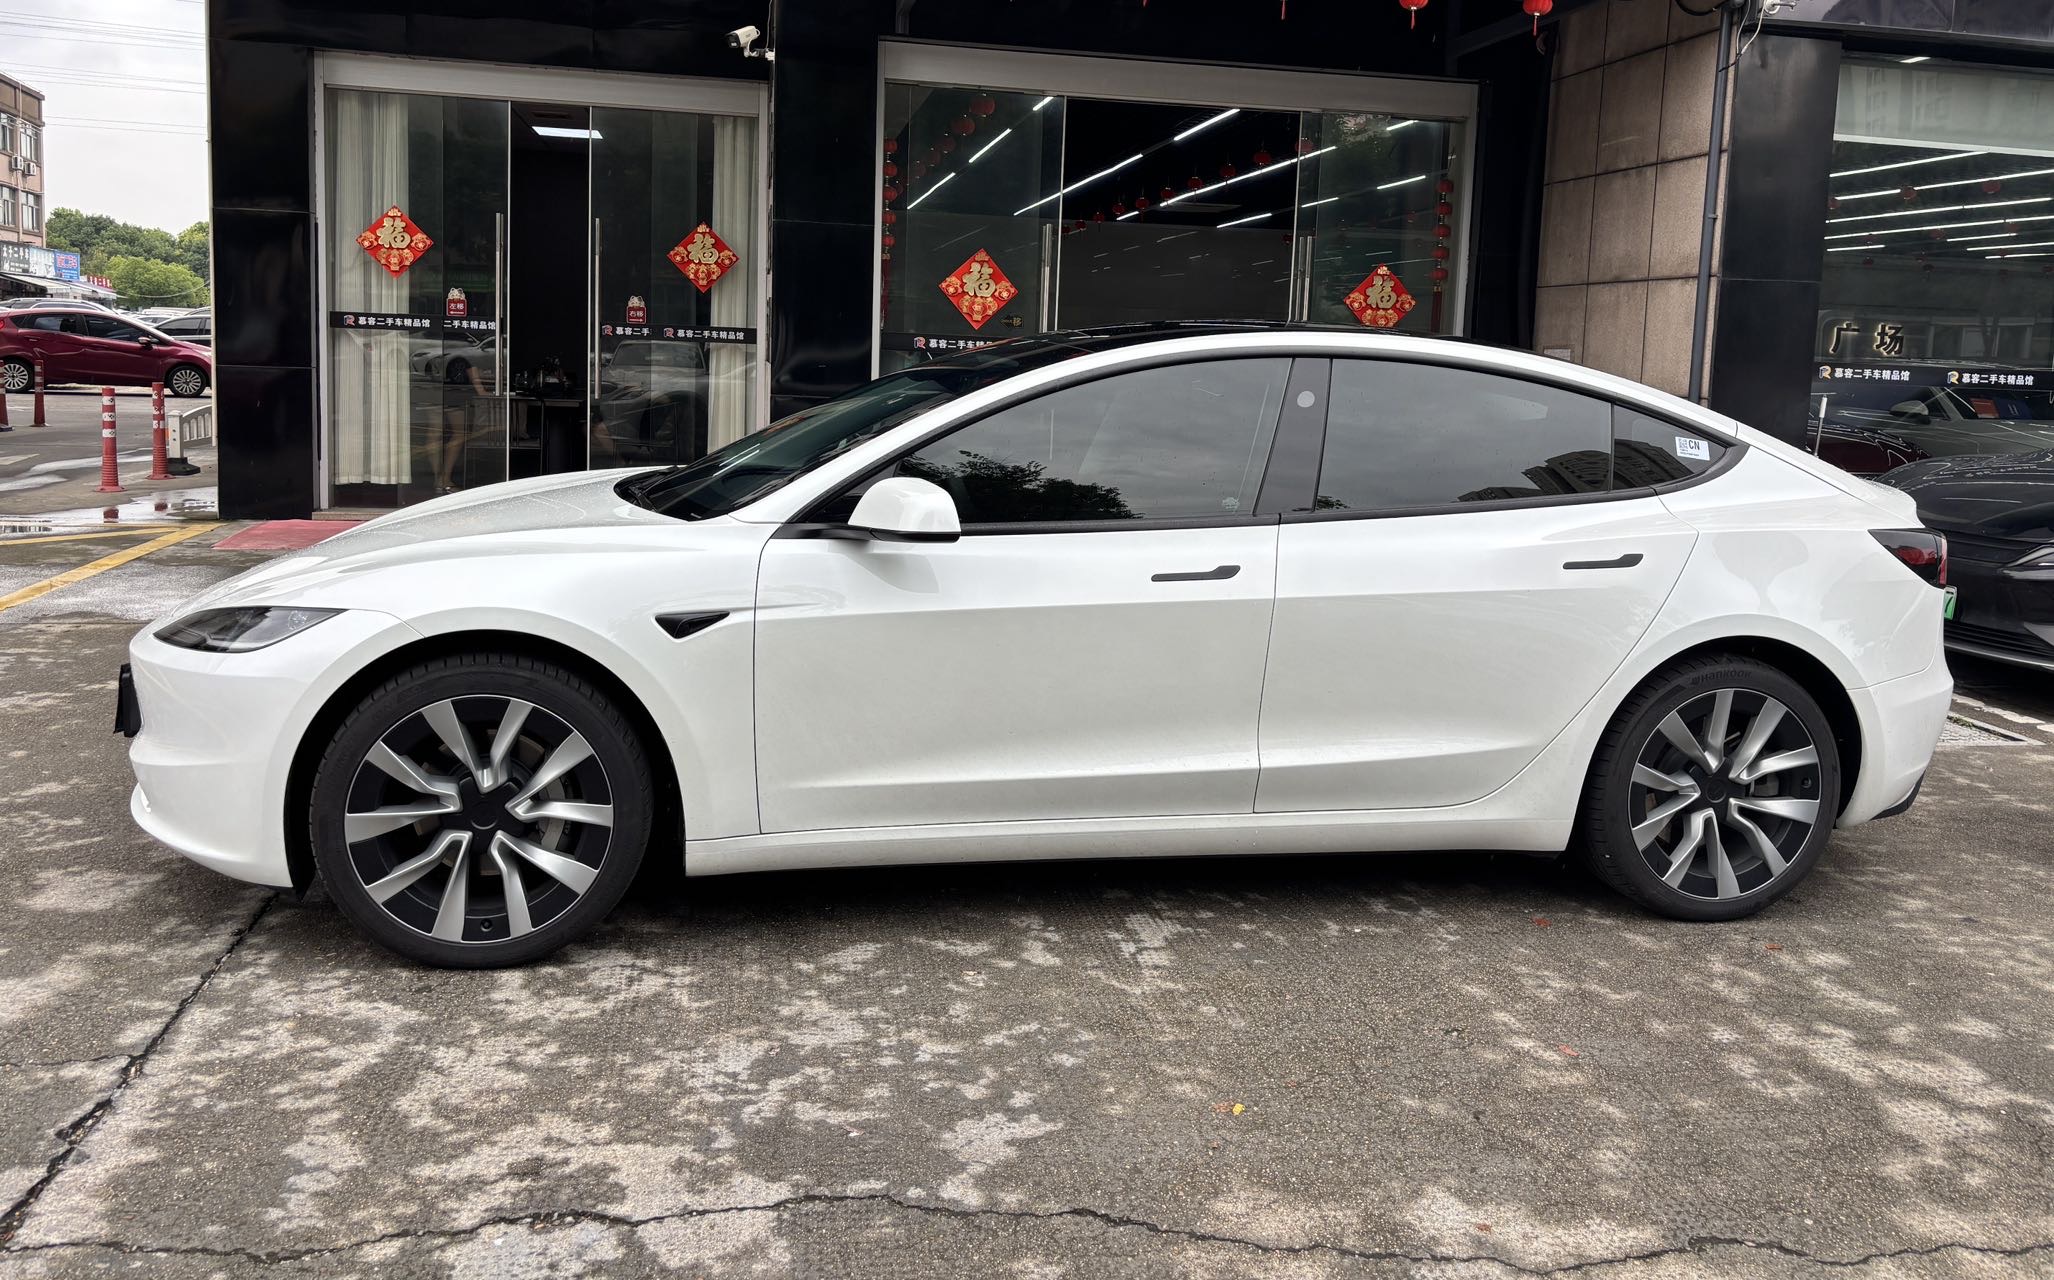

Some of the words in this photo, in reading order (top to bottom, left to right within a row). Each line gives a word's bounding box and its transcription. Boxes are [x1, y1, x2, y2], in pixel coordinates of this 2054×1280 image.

[376, 217, 411, 249] 福
[687, 233, 719, 264] 福
[962, 261, 996, 297] 福
[1366, 275, 1397, 309] 福
[615, 327, 651, 336] 慕容二手
[1829, 321, 1904, 356] 广场
[1834, 367, 1911, 381] 慕容二手车精品馆
[1962, 373, 2035, 386] 慕容二手车精品馆
[1688, 439, 1700, 450] CN
